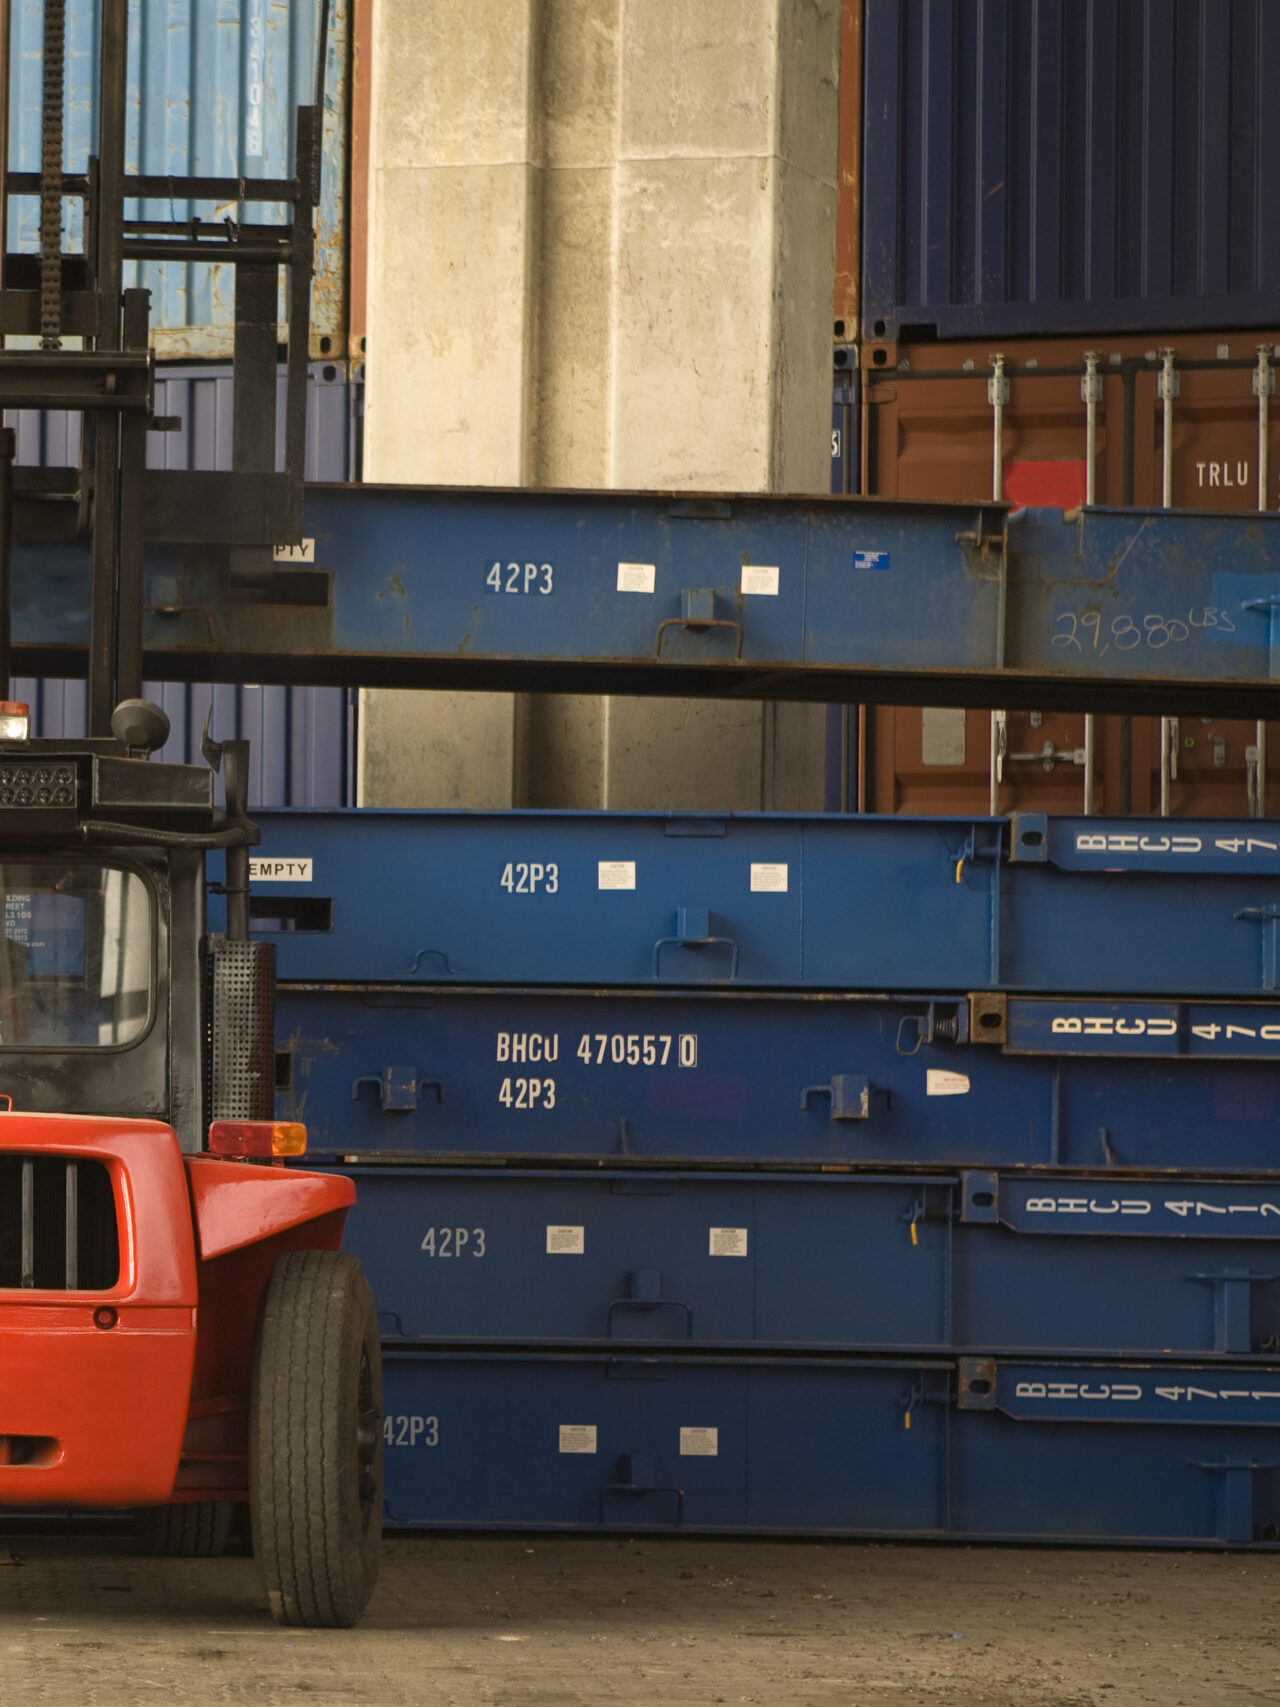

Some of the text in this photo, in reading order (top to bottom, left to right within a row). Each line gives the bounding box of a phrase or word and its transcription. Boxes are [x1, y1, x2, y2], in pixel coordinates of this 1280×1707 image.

[1196, 461, 1248, 488] TRLU
[486, 562, 553, 595] 42P3
[1051, 611, 1190, 657] 29,880
[1076, 835, 1202, 853] BHCU
[248, 863, 308, 876] EMPTY
[500, 863, 559, 894] 42P3
[1051, 1017, 1178, 1036] BHCU
[496, 1032, 696, 1067] BHCU 470557 0
[498, 1077, 556, 1109] 42P3
[1026, 1197, 1152, 1215] BHCU
[421, 1227, 486, 1258] 42P3
[1015, 1383, 1142, 1400] BHCU
[384, 1415, 439, 1446] 42P3
